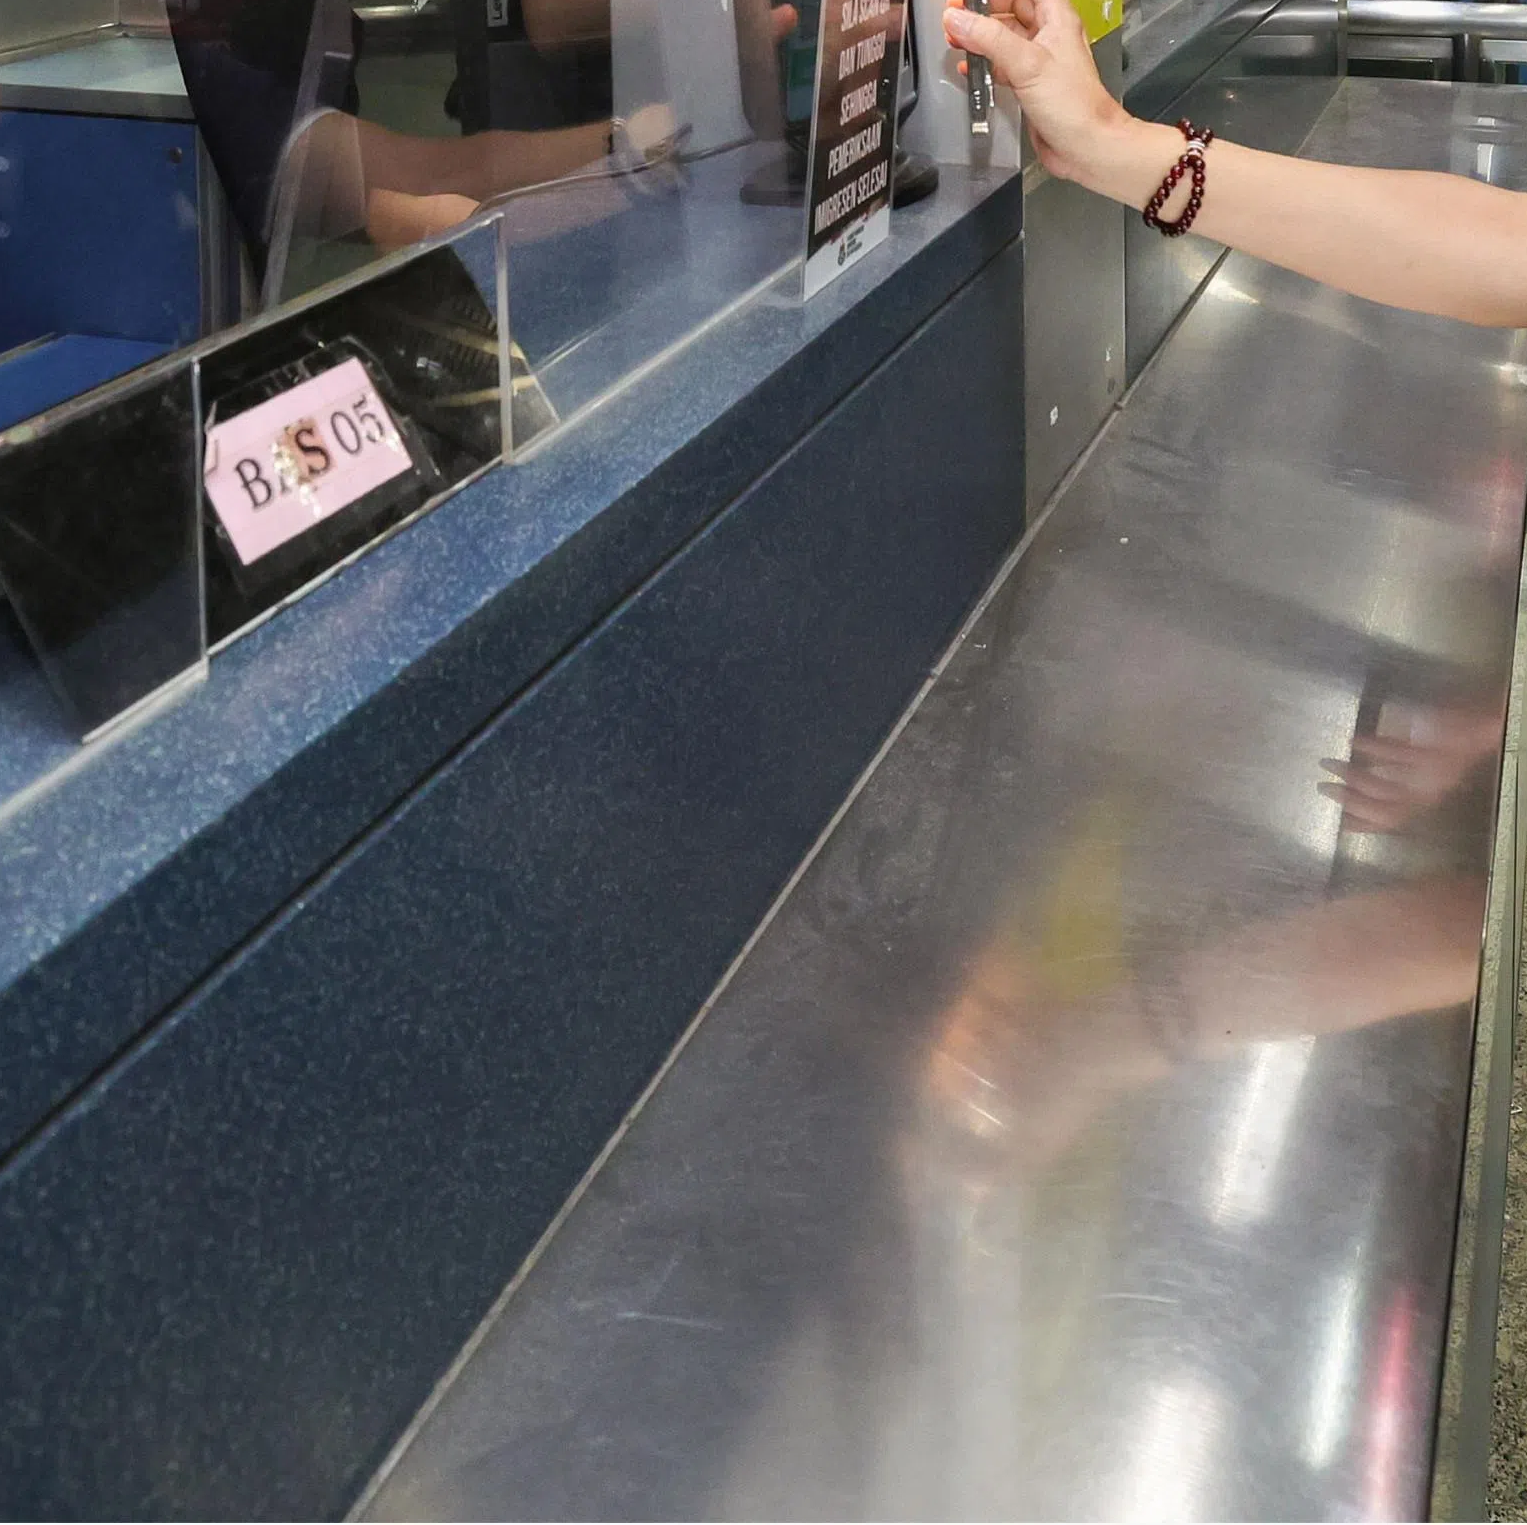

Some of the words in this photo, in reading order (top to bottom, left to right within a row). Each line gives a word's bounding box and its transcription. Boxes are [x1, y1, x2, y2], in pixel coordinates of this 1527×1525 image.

[838, 45, 857, 81] DAN
[856, 30, 887, 71] TUNGGU
[840, 79, 878, 126] SEHINGGA
[828, 120, 883, 179] PEMERIKSAAN
[814, 180, 858, 235] IMIGRESEN
[857, 159, 888, 205] SELESAI
[331, 394, 385, 456] 05
